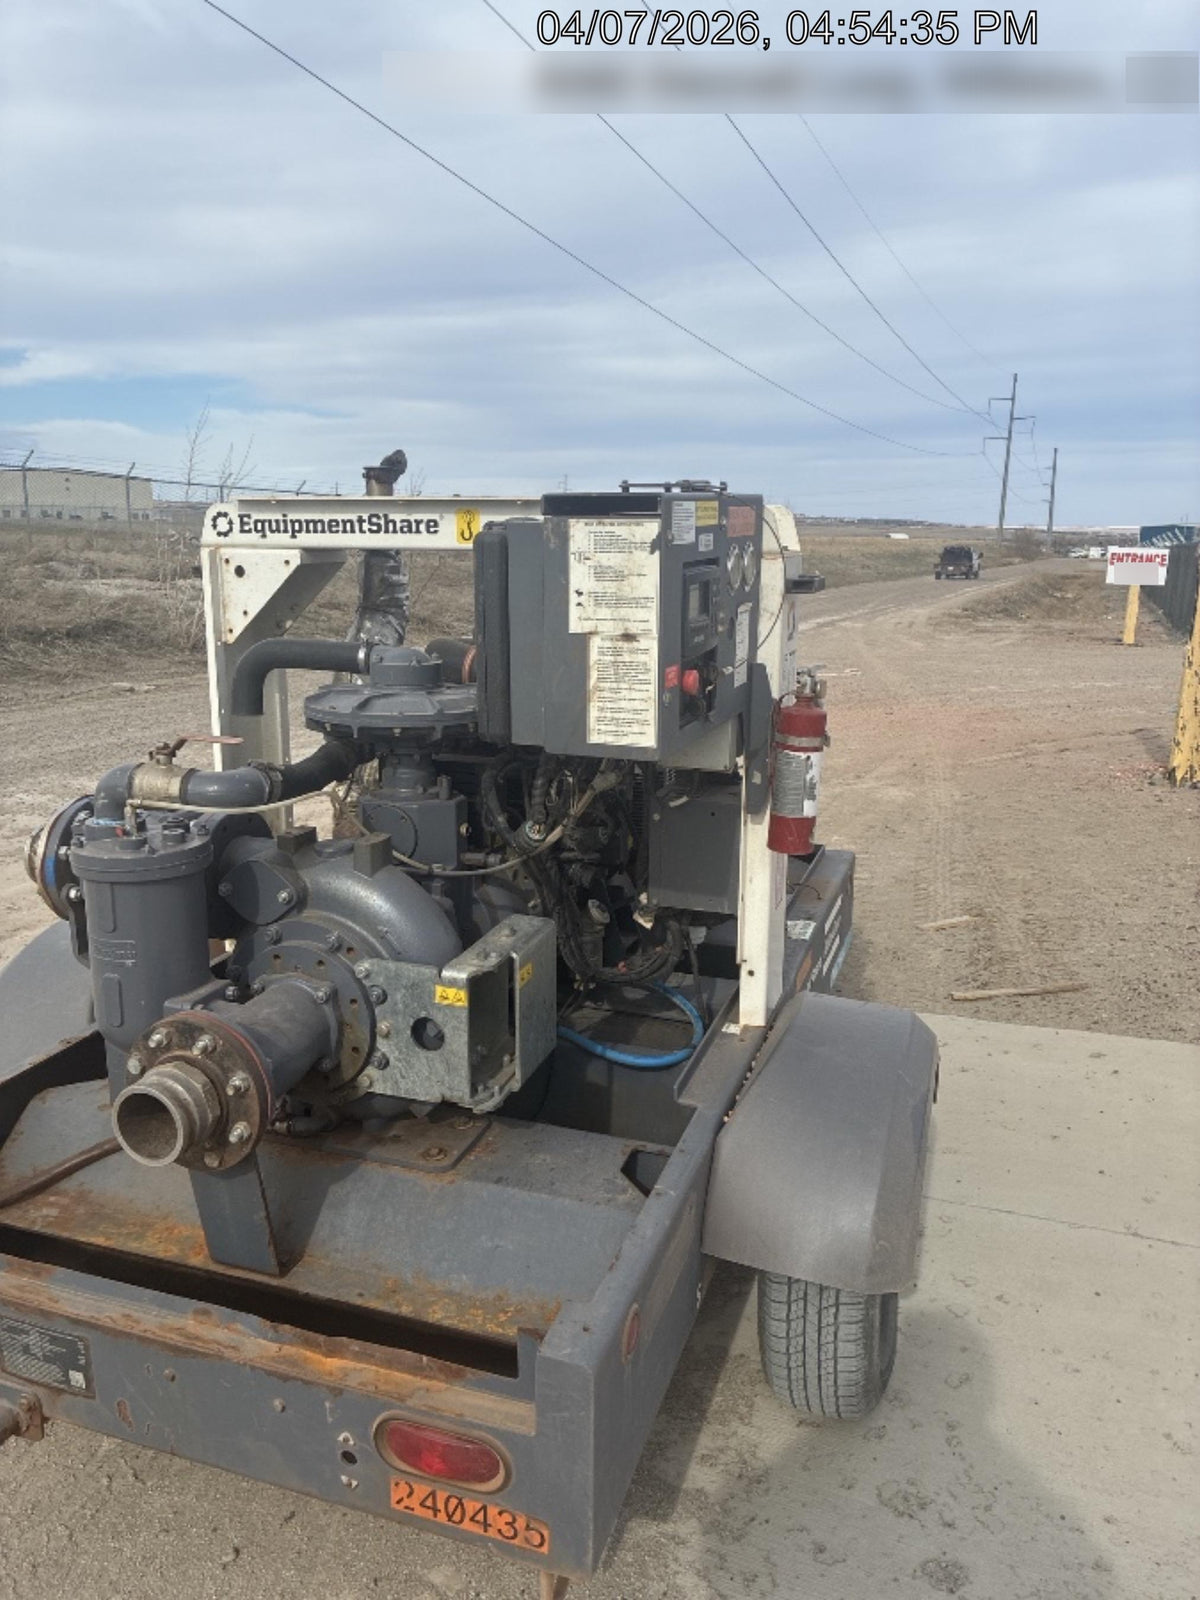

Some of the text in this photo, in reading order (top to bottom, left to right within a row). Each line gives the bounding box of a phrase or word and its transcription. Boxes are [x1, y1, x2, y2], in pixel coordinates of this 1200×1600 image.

[238, 513, 440, 538] EquipmentShare
[1109, 552, 1168, 567] ENTRANCE
[394, 1480, 546, 1549] 240435
